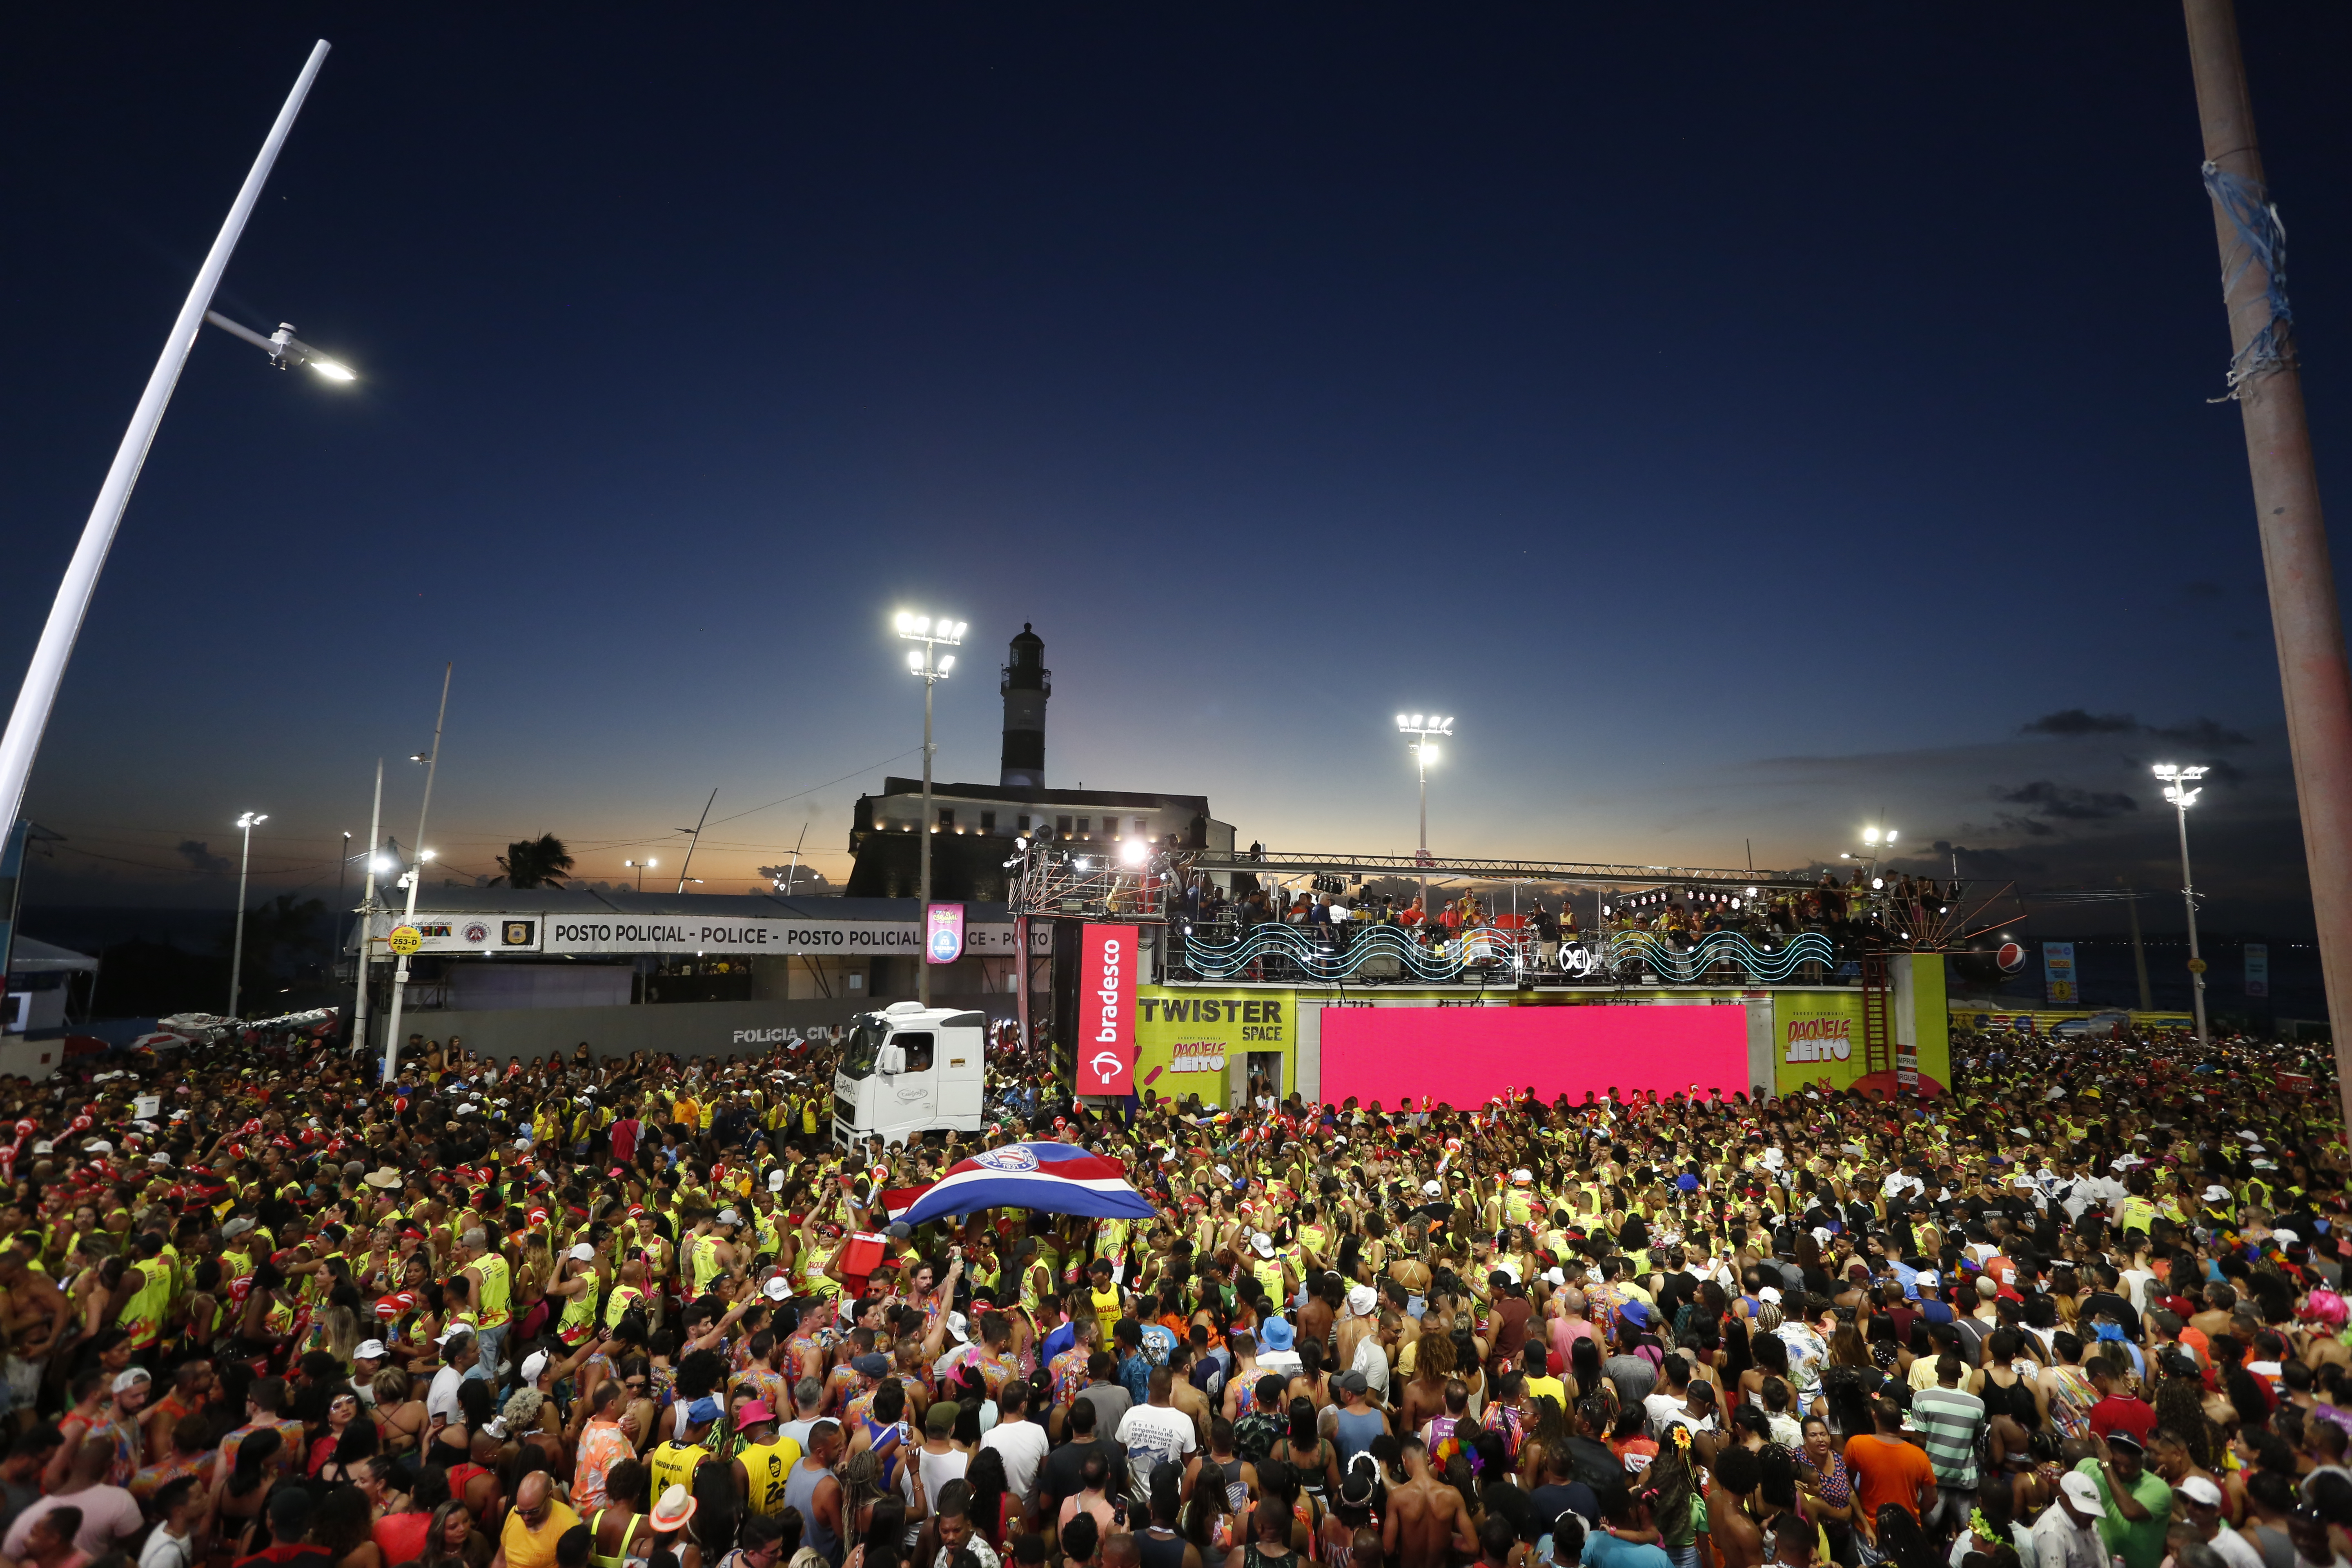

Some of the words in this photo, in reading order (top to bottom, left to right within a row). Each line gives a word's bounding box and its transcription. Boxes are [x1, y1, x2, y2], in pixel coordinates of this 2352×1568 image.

[556, 925, 610, 942] POSTO
[616, 925, 685, 942] POLICIAL
[701, 927, 767, 944] POLICE
[788, 930, 843, 945] POSTO
[850, 931, 920, 945] POLICIAL
[1095, 939, 1120, 1042] bradesco
[1139, 999, 1282, 1023] TWISTER
[1242, 1026, 1282, 1041] SPACE
[1788, 1017, 1852, 1044] DAQUELE
[1172, 1041, 1227, 1059] DAQUELE
[1785, 1038, 1851, 1064] JEITO
[1170, 1056, 1225, 1073] JEITO
[1133, 1421, 1173, 1434] Nothing
[1149, 1434, 1172, 1443] pleasure
